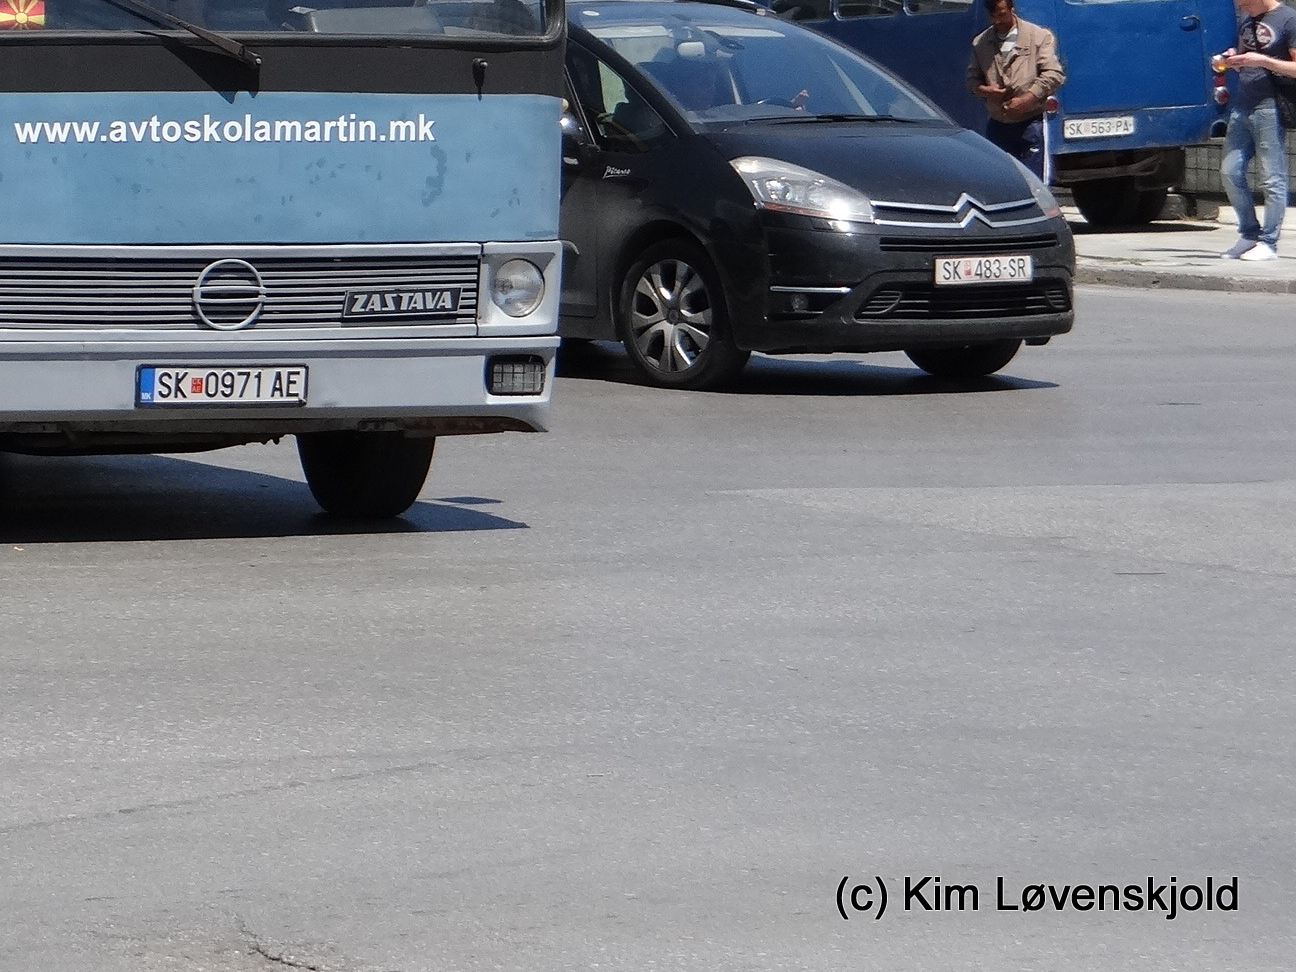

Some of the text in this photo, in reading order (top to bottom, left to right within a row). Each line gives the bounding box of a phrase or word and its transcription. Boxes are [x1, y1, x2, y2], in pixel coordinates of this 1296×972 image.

[14, 113, 436, 144] www.avtoskolamartin.mk
[1069, 123, 1083, 135] SK
[942, 260, 962, 280] SK
[350, 291, 453, 312] ZASTAVA
[157, 371, 301, 399] SK 0971 AE
